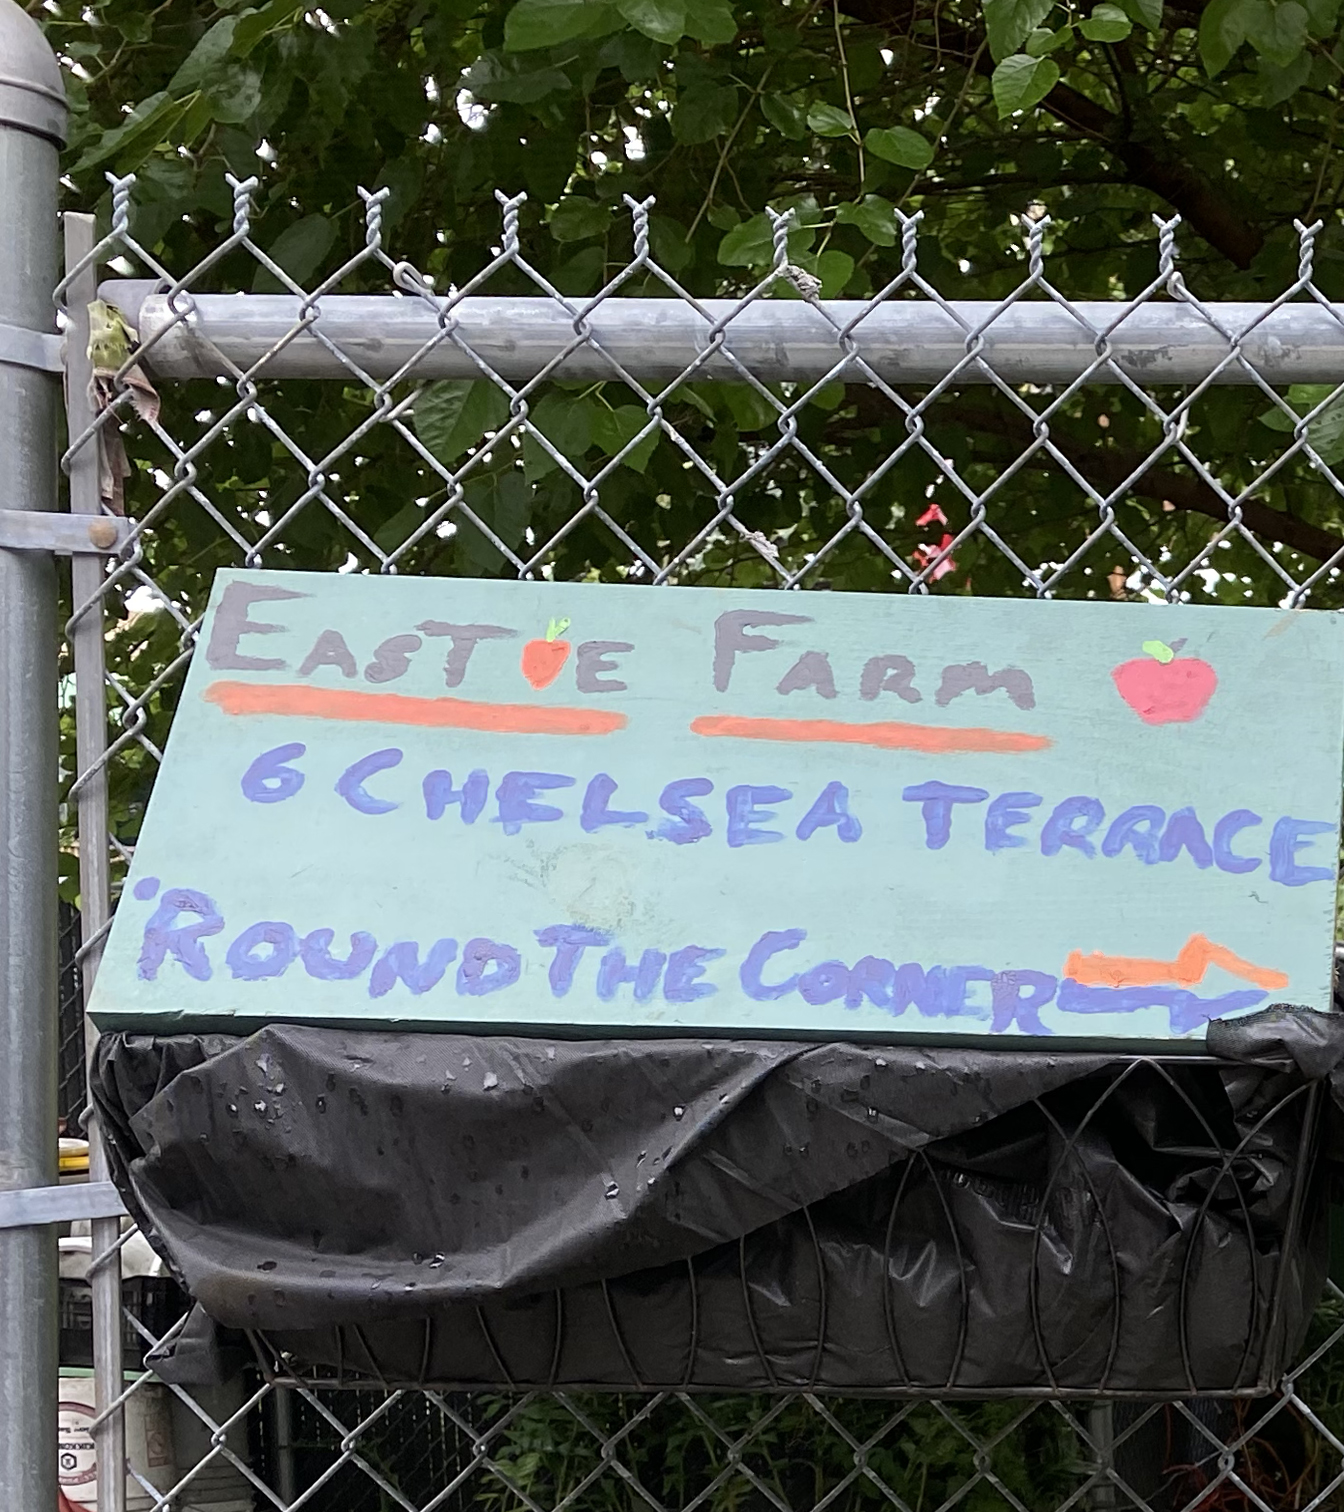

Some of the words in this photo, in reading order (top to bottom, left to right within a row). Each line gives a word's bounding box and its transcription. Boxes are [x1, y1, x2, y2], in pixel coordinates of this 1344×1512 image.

[712, 608, 1037, 711] FARM
[241, 742, 307, 804] 6
[335, 746, 863, 850] CHELSEA
[901, 780, 1338, 888] TERRACE
[533, 923, 727, 1005] THE
[739, 927, 1058, 1036] CORNER
